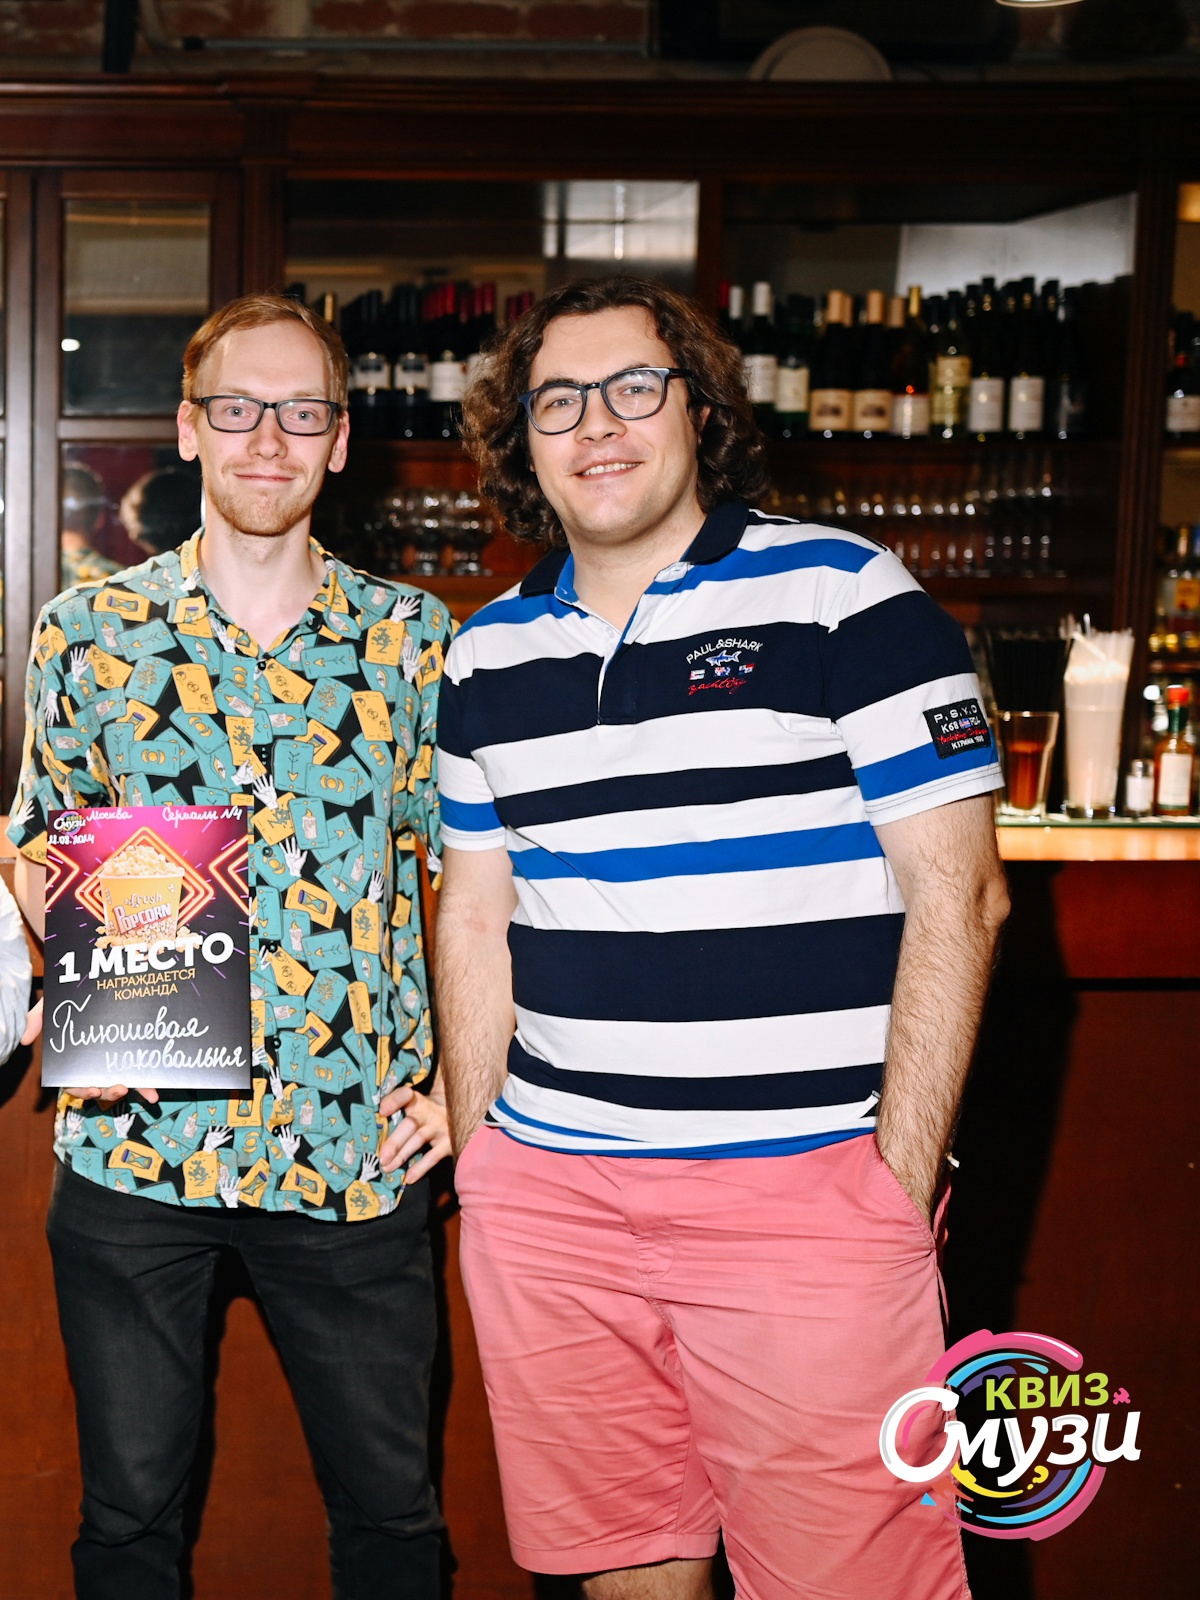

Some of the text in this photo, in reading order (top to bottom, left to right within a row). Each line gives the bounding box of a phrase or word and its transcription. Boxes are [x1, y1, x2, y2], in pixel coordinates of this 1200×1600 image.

[686, 638, 764, 665] PAUL&SHARK
[940, 720, 960, 734] K68
[53, 814, 87, 831] Смузи
[86, 808, 134, 822] Москва
[162, 805, 219, 829] Сериалы
[130, 892, 163, 907] fresh
[112, 902, 172, 934] POPCORN
[58, 931, 235, 983] 1 МЕСТО
[96, 968, 197, 991] НАГРАЖДАЕТСЯ
[114, 984, 179, 1001] КОМАНДА
[49, 993, 210, 1054] Плюшевая
[104, 1038, 247, 1072] наковальня
